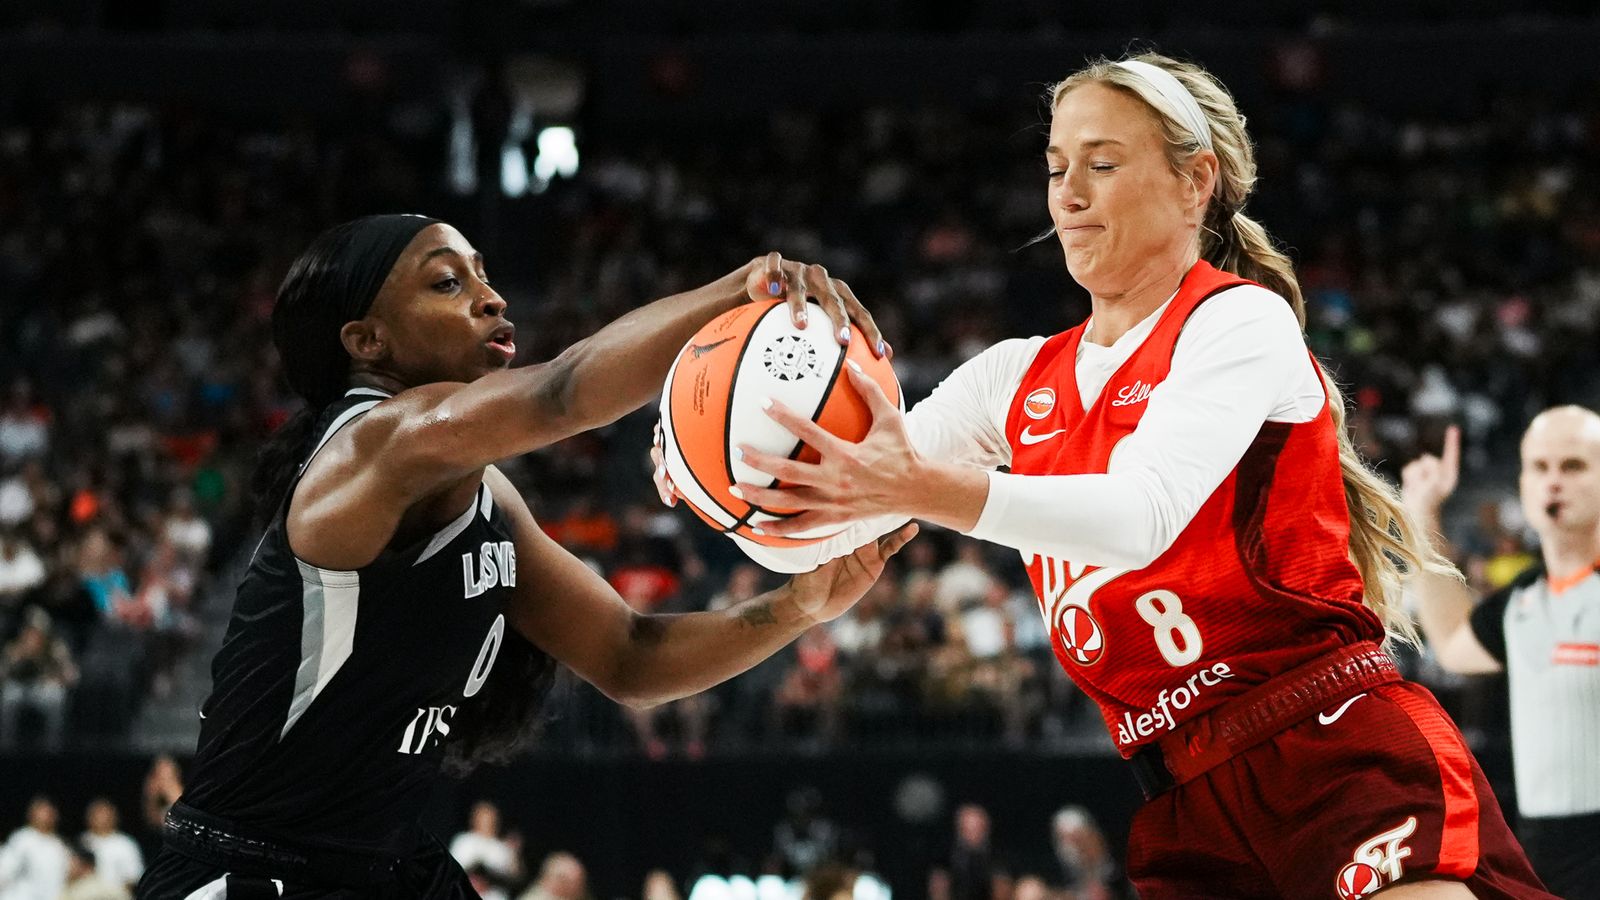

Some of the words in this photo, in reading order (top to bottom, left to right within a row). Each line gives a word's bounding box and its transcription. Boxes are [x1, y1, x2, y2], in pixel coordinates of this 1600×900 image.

[1112, 380, 1152, 407] Lill
[463, 613, 505, 697] 0
[1135, 588, 1203, 667] 8
